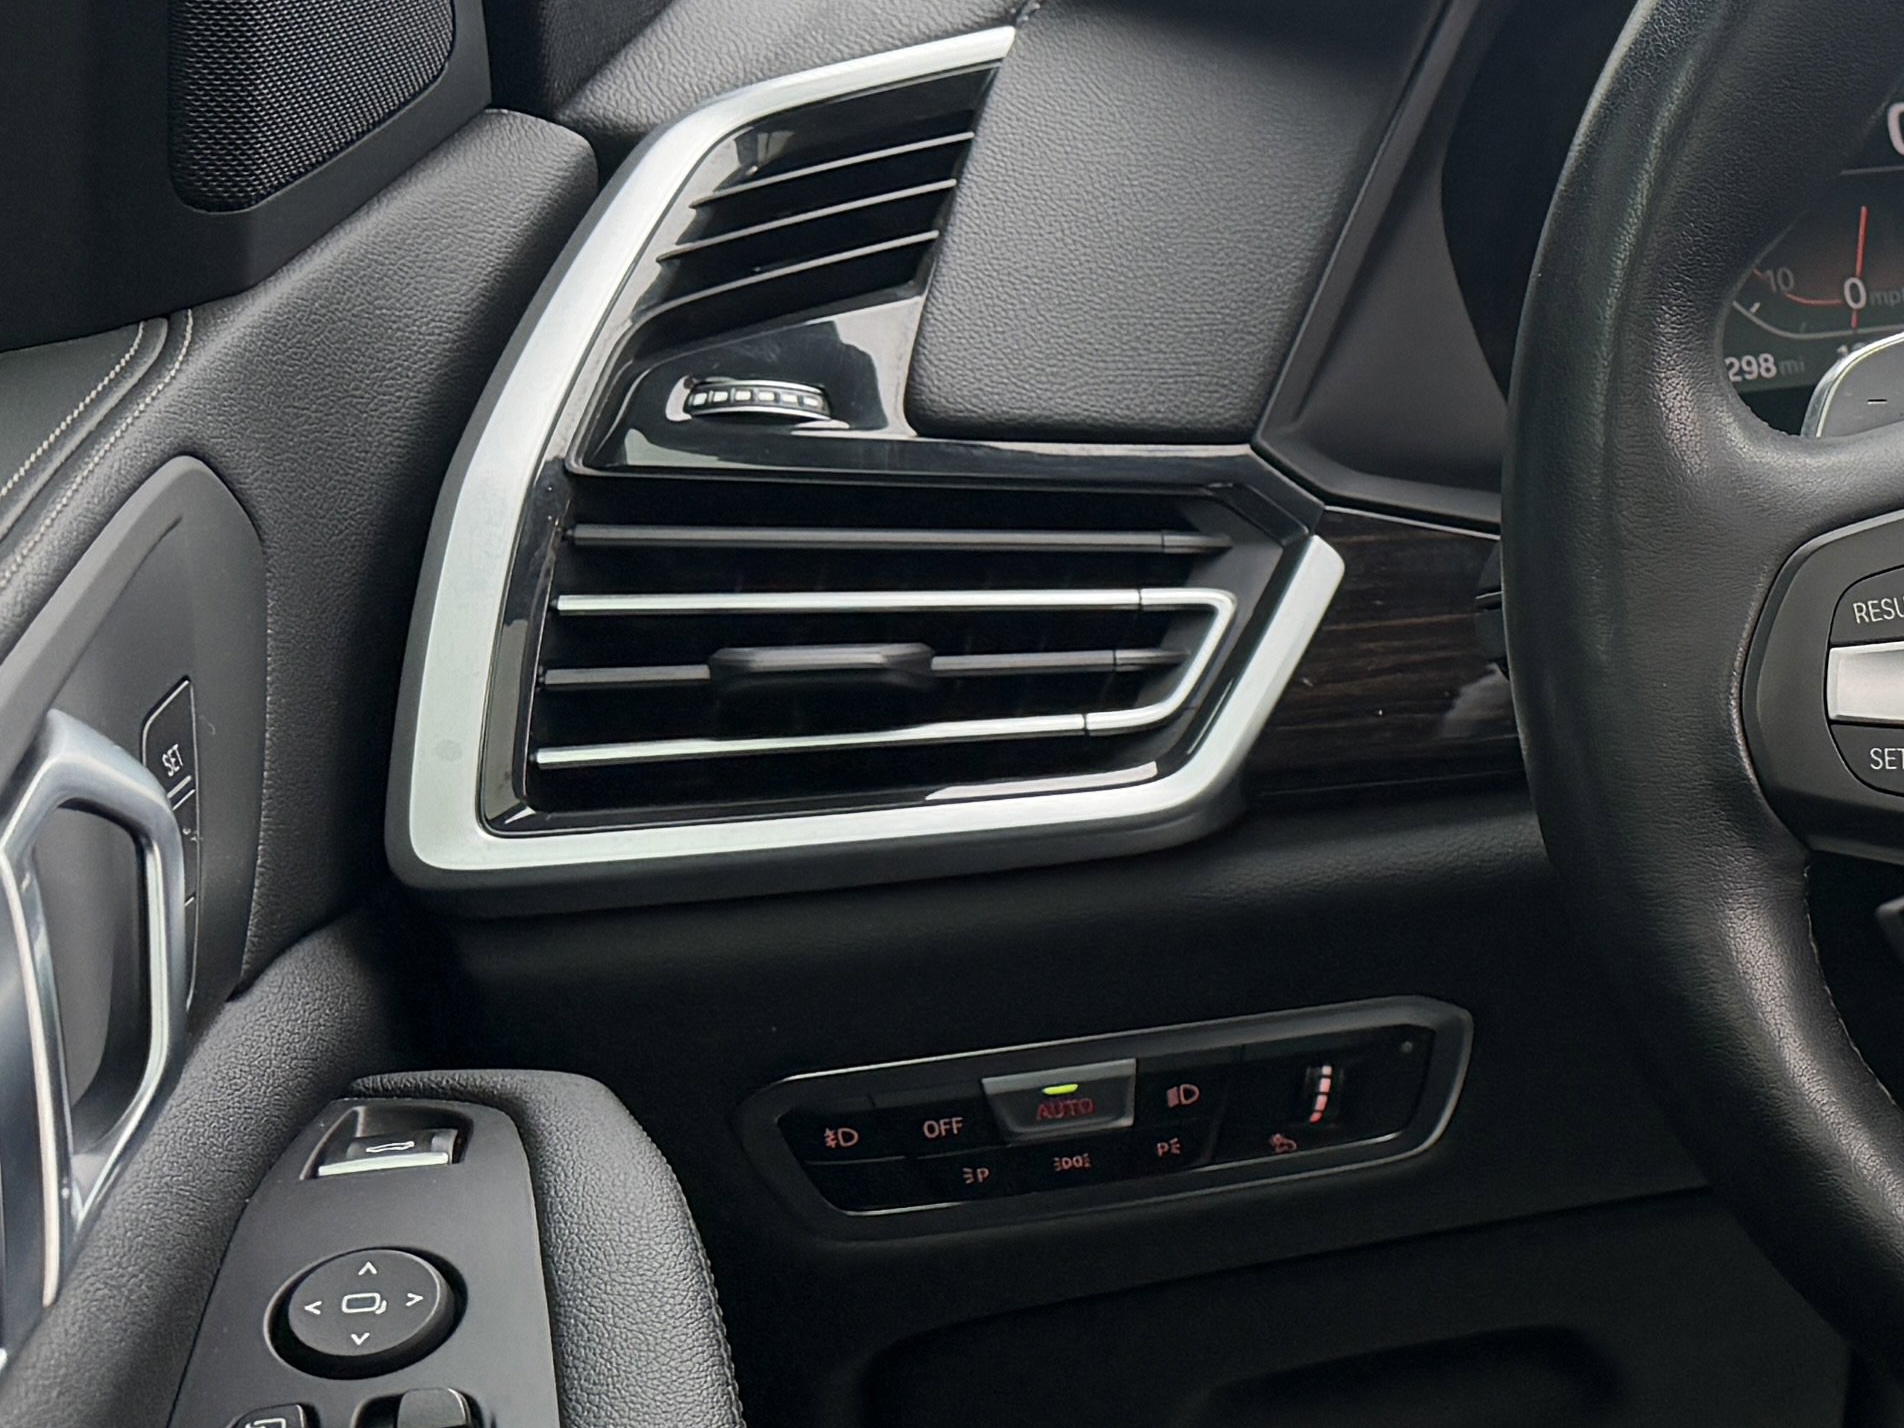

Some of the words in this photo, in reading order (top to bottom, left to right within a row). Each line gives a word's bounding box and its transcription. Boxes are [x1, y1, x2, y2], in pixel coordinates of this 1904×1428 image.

[1843, 277, 1867, 310] 0
[1725, 353, 1777, 382] 298
[160, 743, 183, 778] SET
[1036, 1097, 1095, 1121] AUTO
[923, 1115, 964, 1139] OFF
